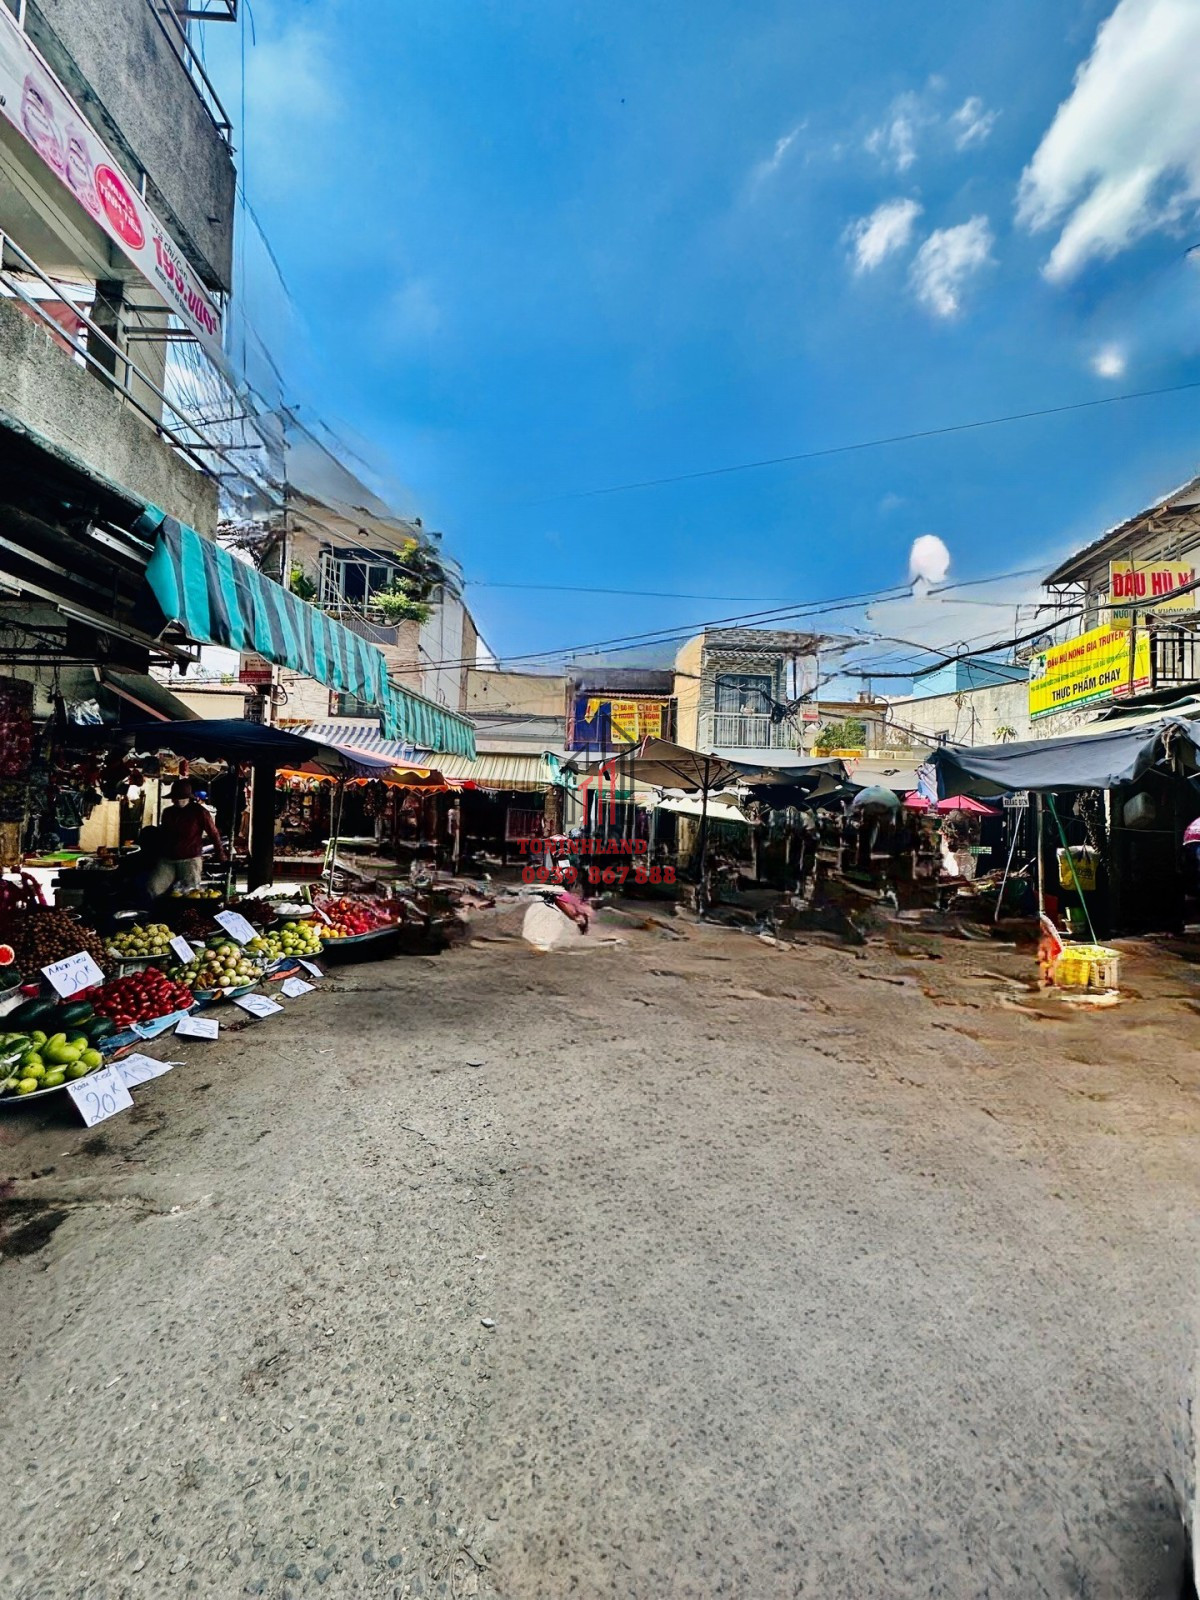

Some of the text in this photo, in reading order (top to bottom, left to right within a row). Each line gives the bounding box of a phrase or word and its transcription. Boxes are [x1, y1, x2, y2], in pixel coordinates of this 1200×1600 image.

[1086, 640, 1097, 653] GIA
[1052, 685, 1071, 702] THỰC
[1073, 674, 1097, 693] PHẨM
[1098, 668, 1121, 687] CHAY
